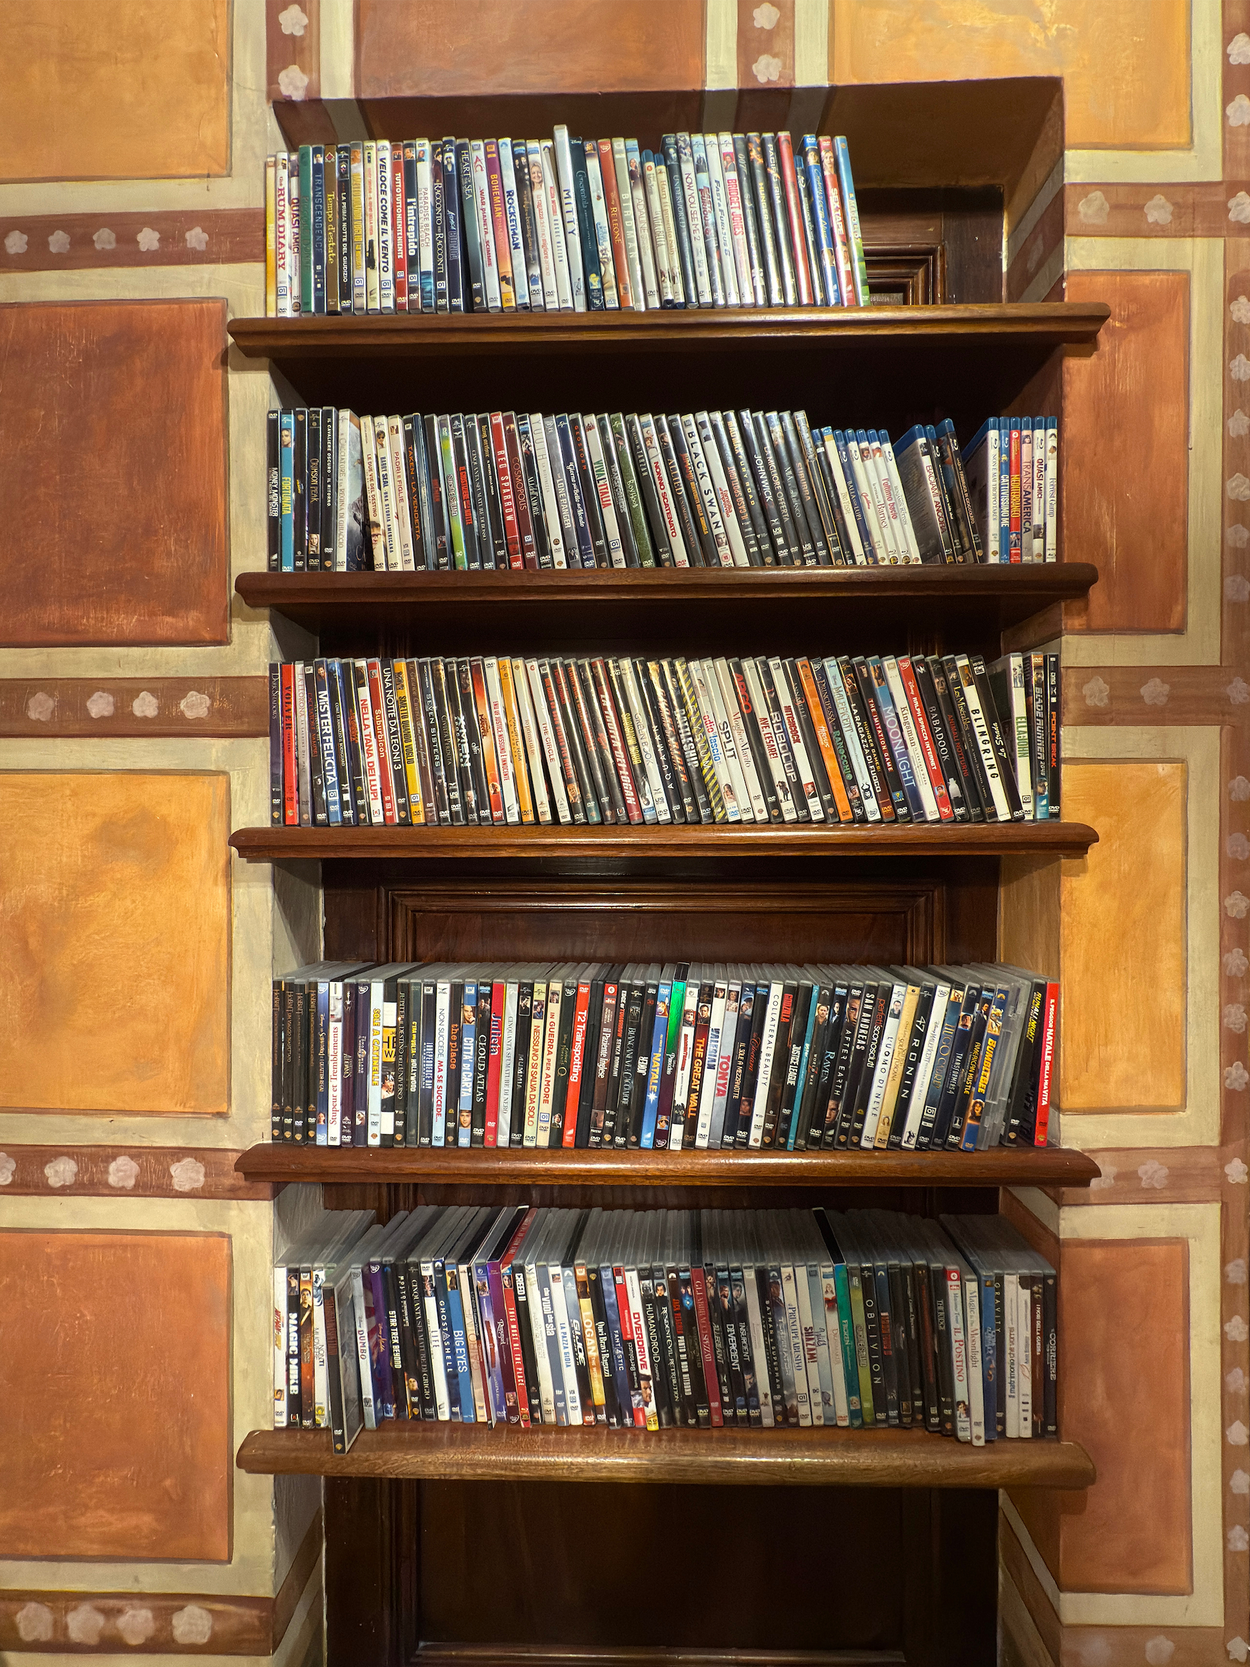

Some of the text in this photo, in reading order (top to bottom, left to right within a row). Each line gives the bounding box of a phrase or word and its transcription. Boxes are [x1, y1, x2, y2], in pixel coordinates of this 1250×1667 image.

[341, 192, 347, 200] LA
[461, 150, 472, 200] HEART SEA
[491, 174, 502, 217] BOHEMIAN
[277, 188, 286, 271] RUM DIARY
[291, 198, 300, 229] QUASI
[326, 192, 335, 264] Tempo d'estate
[379, 157, 389, 273] VELOCE COME IL VENTO
[407, 198, 417, 256] l'intrepido
[506, 190, 520, 250] ROCKETMAN
[563, 189, 576, 236] MITTY
[621, 193, 636, 258] BIRDMAN
[727, 179, 744, 236] BRIDGET JONES
[831, 188, 844, 235] SEX TAPE
[574, 426, 586, 470] GEOSTORM
[282, 477, 291, 514] FORTUNATA
[411, 481, 416, 492] LA
[497, 450, 514, 521] RED SPARROW
[513, 457, 527, 511] COSMOPOLIS
[667, 458, 683, 495] ALLIED
[687, 431, 722, 530] BLACK SWAN
[754, 454, 773, 502] JOHN WICK
[796, 462, 810, 502] SUBURRA
[1023, 460, 1031, 534] TRANSAMERICA
[557, 478, 571, 528] LONE RANGER
[654, 461, 677, 538] NONNO SCATENATO
[383, 668, 392, 689] UNA
[733, 672, 752, 714] ARGO
[284, 685, 292, 730] VOLVER
[385, 690, 395, 718] NOTTE
[784, 706, 801, 744] HITCHCOCK
[851, 703, 858, 715] LA
[374, 709, 385, 758] Suburbicon
[388, 720, 396, 733] DA
[389, 735, 399, 762] LEONI
[426, 694, 440, 767] SEVEN SISTERS
[675, 709, 699, 768] BATTLESHIP
[719, 721, 736, 760] SPLIT
[854, 716, 868, 754] RAGAZZA
[868, 699, 893, 772] THE IMITATION GAME
[885, 706, 916, 787] MOONLIGHT
[901, 706, 915, 747] Kingsman
[913, 697, 937, 770] RALPH SPACCA INTERNET
[929, 706, 950, 762] BABADOOK
[360, 699, 378, 800] NELLA TANA DEI LUPI
[866, 756, 873, 765] DI
[869, 766, 882, 792] FUOCO
[780, 993, 793, 1022] GODZILLA
[856, 993, 874, 1050] SAN ANDREAS
[450, 1042, 458, 1069] place
[490, 1012, 501, 1055] Julieta
[531, 1026, 540, 1061] NESSUNO
[547, 1021, 555, 1056] GUERRA
[570, 1010, 587, 1082] T2 Trainspotting
[762, 994, 779, 1087] COLLATERAL BEAUTY
[939, 1024, 955, 1056] HUGO
[476, 1035, 486, 1102] CLOUD ATLAS
[649, 1053, 661, 1092] NATALE
[688, 1038, 705, 1118] THE GREAT WALL
[716, 1055, 730, 1097] TONYA
[834, 1029, 852, 1096] AFTER EARTH
[901, 1016, 926, 1099] 47 RONIN
[978, 1038, 997, 1094] BUMBLEBEE
[529, 1071, 537, 1093] SALVA
[529, 1094, 535, 1105] DA
[543, 1073, 551, 1104] AMORE
[515, 1273, 525, 1294] CREED
[388, 1310, 397, 1326] STAR
[439, 1301, 453, 1372] GHOST SHELL
[583, 1312, 595, 1356] LOGAN
[289, 1313, 298, 1395] MAGIC MIKE
[358, 1330, 366, 1360] DUMBO
[392, 1345, 401, 1369] BEYOND
[453, 1330, 467, 1373] BIG EYES
[561, 1332, 569, 1350] PAZZA
[563, 1352, 571, 1368] GIOIA
[633, 1312, 648, 1370] OVERDRIVE
[726, 1324, 740, 1372] DIVERGENT
[739, 1322, 750, 1362] INSURGENT
[804, 1327, 817, 1363] SHAZAM!
[866, 1299, 881, 1384] OBLIVION
[421, 1373, 430, 1399] GRIGIO
